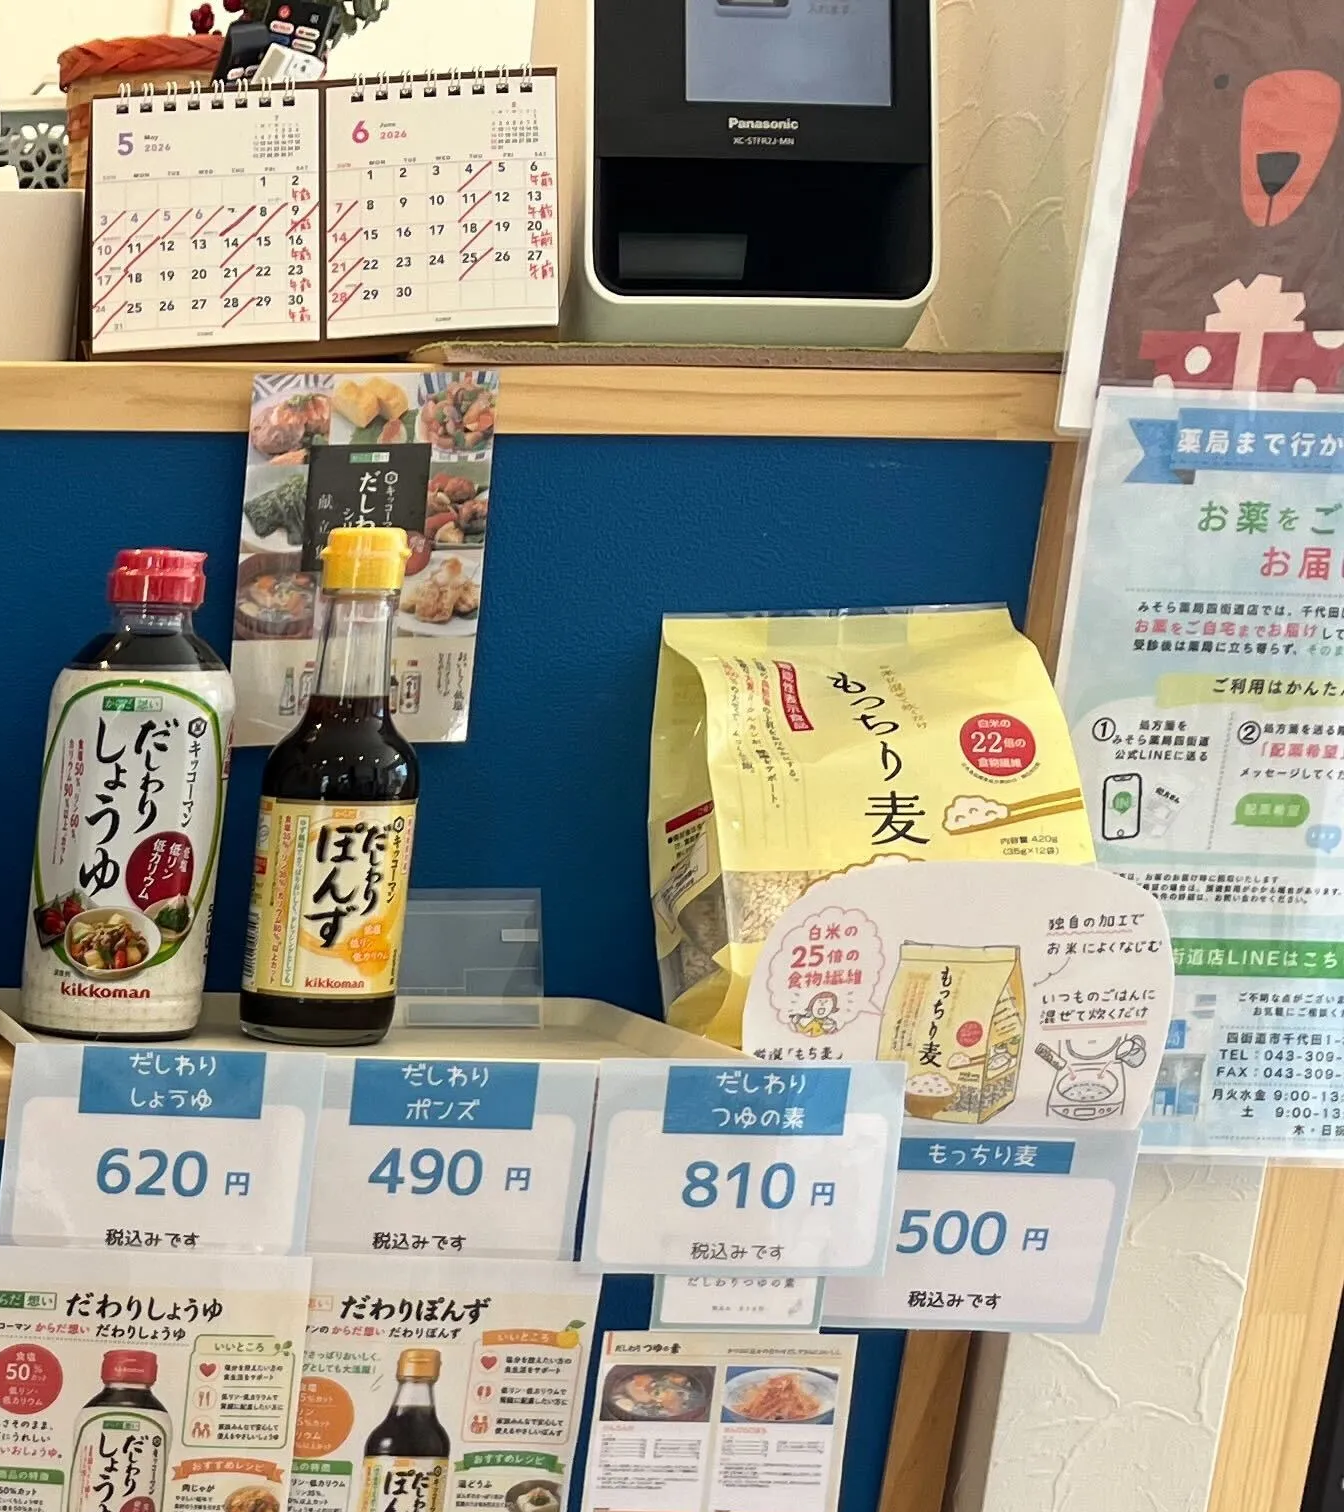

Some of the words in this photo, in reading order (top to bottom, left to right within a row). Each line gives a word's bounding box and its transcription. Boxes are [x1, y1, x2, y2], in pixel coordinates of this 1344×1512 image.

[380, 130, 407, 140] 2026
[729, 117, 799, 130] Panasonic
[144, 143, 171, 152] 2026
[1197, 501, 1342, 535] お薬をご
[977, 719, 1011, 728] 白米の
[826, 671, 931, 846] もっちり麦
[134, 719, 179, 834] だしわり
[181, 741, 201, 828] キッコーマン
[79, 717, 127, 897] しょうゆ
[138, 838, 167, 899] 低カリウム
[162, 843, 183, 879] 低リン
[360, 825, 390, 917] だしわり
[387, 835, 402, 903] キッコーマン
[304, 822, 369, 948] ぽんず
[808, 924, 858, 940] 白米の
[1047, 913, 1145, 931] 独自の加工で
[790, 945, 859, 968] 25倍の
[1047, 939, 1163, 957] お米によくなじむ
[60, 982, 151, 999] kikkoman
[304, 977, 364, 989] kikkoman
[1042, 988, 1156, 1006] いつものごはんに
[919, 965, 954, 1069] もっちり麦
[129, 1052, 217, 1076] だしわり
[401, 1062, 490, 1086] だしわり
[716, 1070, 807, 1094] だしわり
[130, 1088, 213, 1111] しょうゆ
[1212, 1089, 1266, 1101] 月火水金
[406, 1100, 480, 1122] ポンズ
[712, 1107, 804, 1130] つゆの素
[928, 1143, 1039, 1168] もっちり麦
[95, 1147, 208, 1198] 620
[225, 1170, 250, 1196] 円
[368, 1147, 483, 1196] 490
[505, 1167, 531, 1192] 円
[681, 1161, 796, 1210] 810
[810, 1182, 835, 1207] 円
[104, 1228, 200, 1249] 税込みです
[372, 1230, 467, 1251] 税込みです
[895, 1209, 1007, 1256] 500
[1022, 1228, 1049, 1251] 円
[690, 1242, 785, 1262] 税込みです
[66, 1292, 223, 1323] だわりしょうゆ
[340, 1295, 491, 1324] だわりぽんず
[908, 1290, 1002, 1310] 税込みです
[214, 1341, 264, 1352] いいところ
[497, 1333, 550, 1343] いいところ
[192, 1459, 264, 1472] おすすめレシピ
